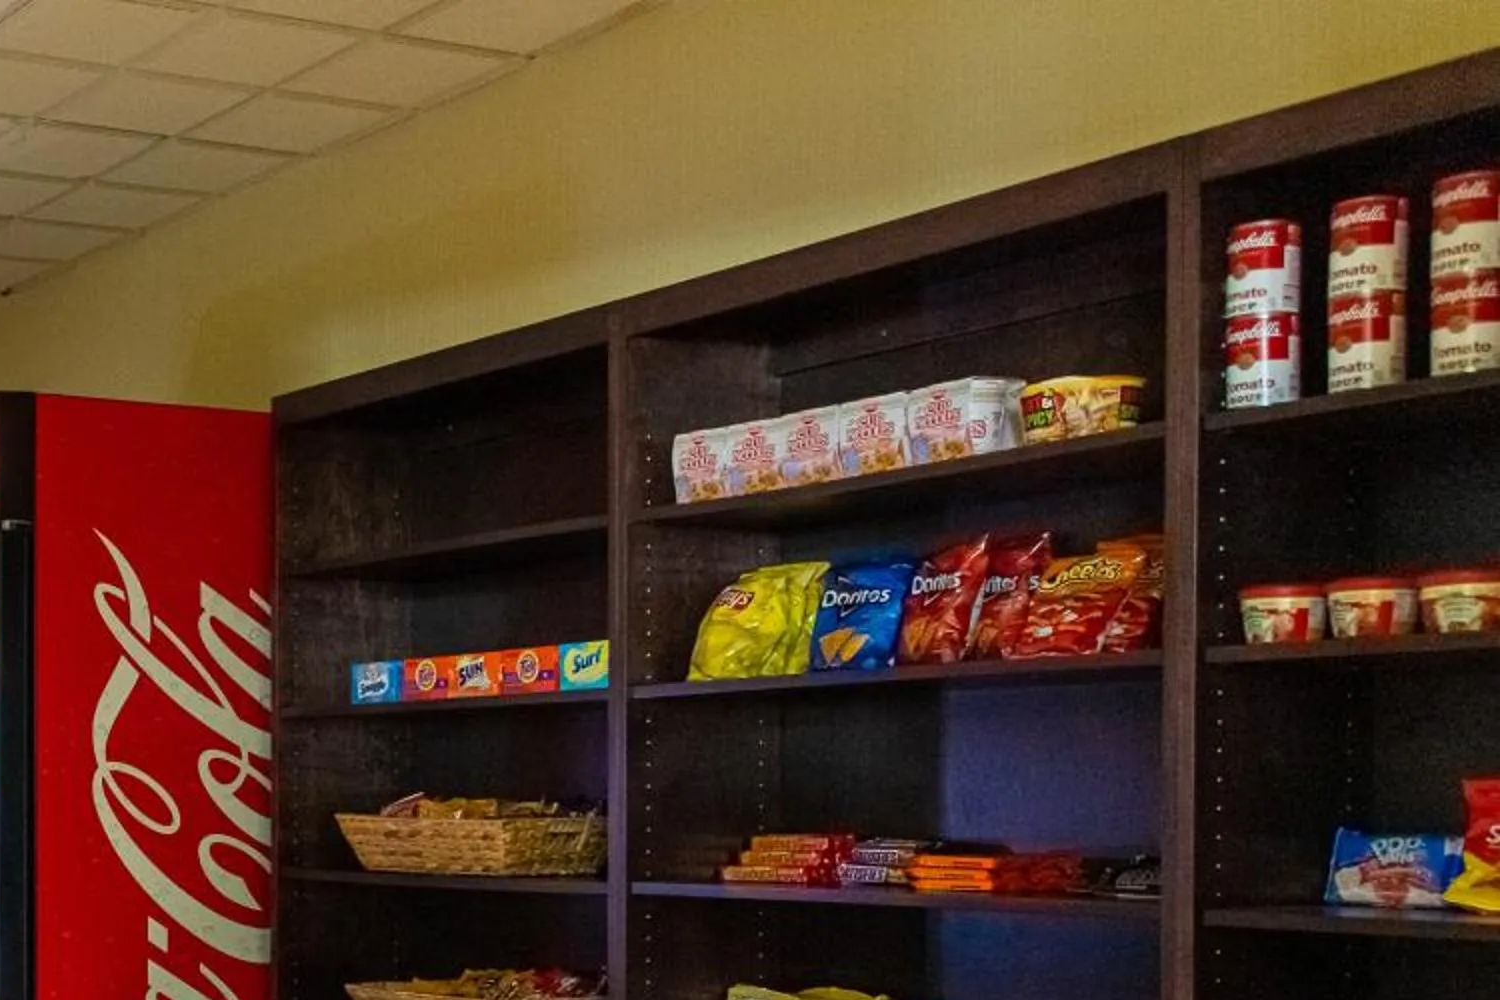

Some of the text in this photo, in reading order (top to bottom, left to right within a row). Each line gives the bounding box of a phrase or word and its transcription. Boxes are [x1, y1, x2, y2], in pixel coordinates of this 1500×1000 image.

[1331, 263, 1377, 278] omato
[911, 573, 962, 595] Doritos
[983, 575, 1019, 593] ritos
[821, 588, 892, 609] Doritos
[570, 644, 604, 675] Surf
